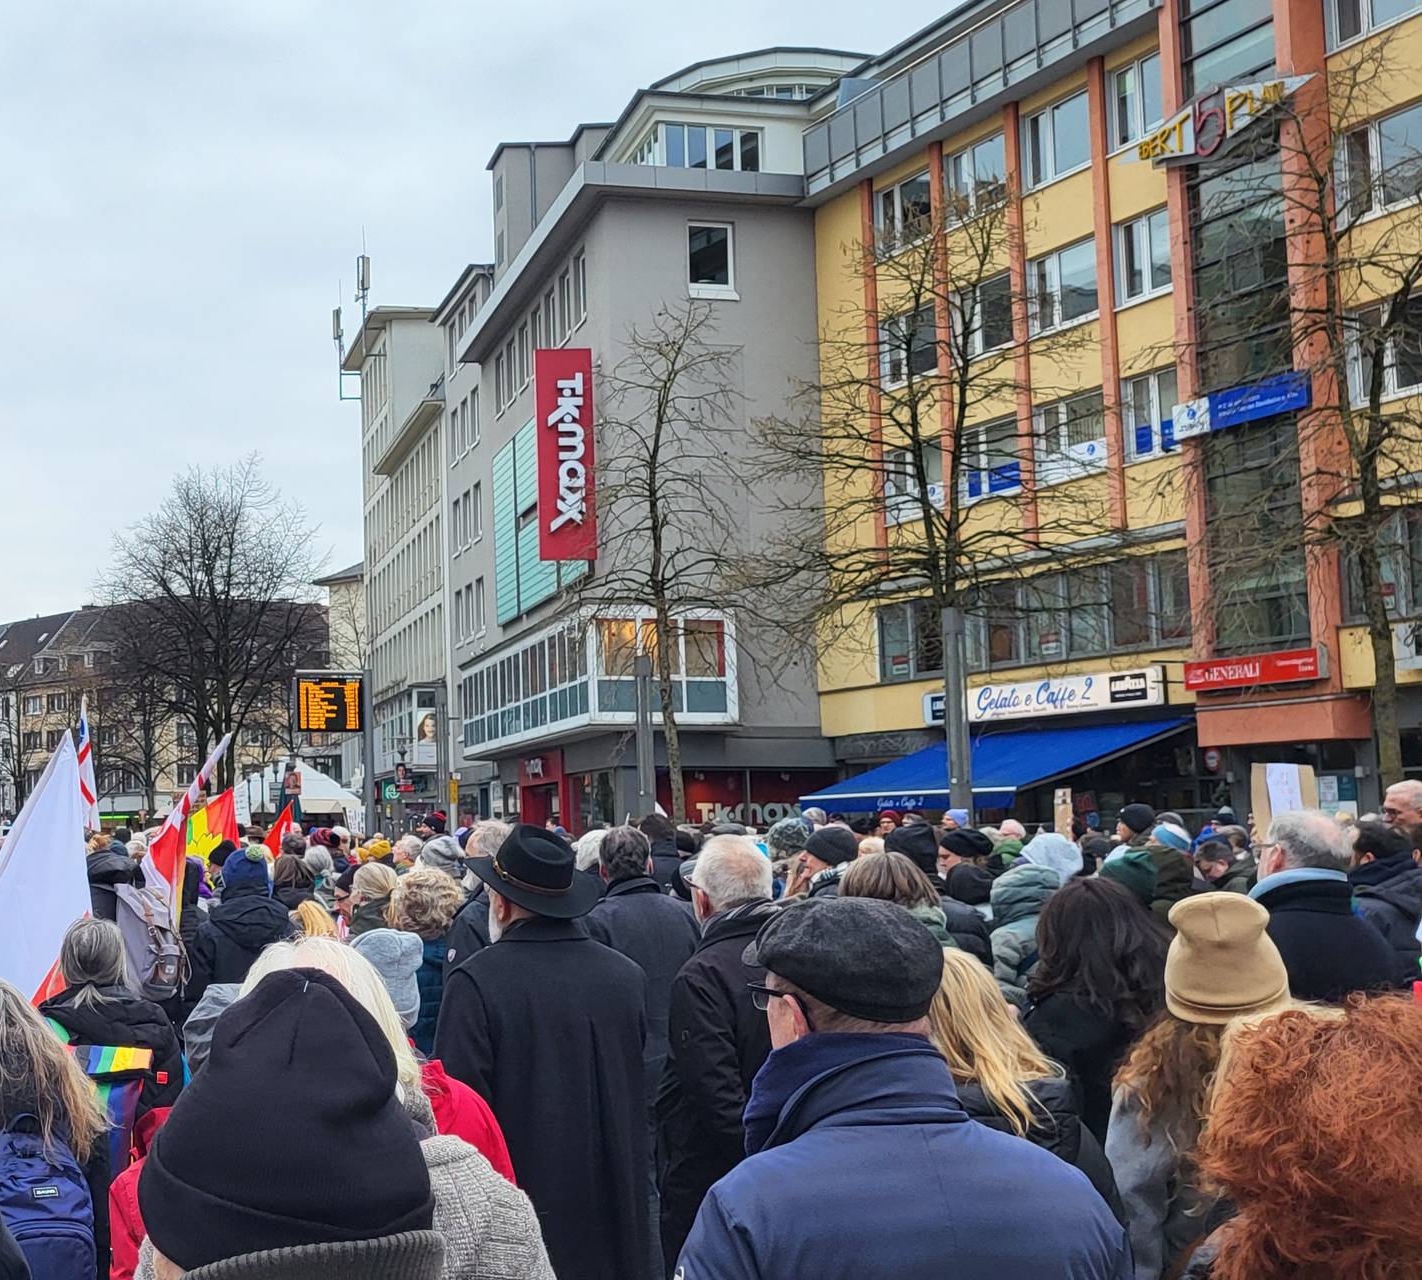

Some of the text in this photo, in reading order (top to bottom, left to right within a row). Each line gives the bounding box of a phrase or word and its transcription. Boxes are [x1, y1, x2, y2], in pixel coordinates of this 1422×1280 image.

[1138, 112, 1191, 161] EBERT
[1195, 86, 1226, 157] 5
[1205, 662, 1260, 681] GENERALI
[975, 687, 1019, 719] Gelato
[1024, 694, 1032, 706] e
[1082, 677, 1093, 700] 2
